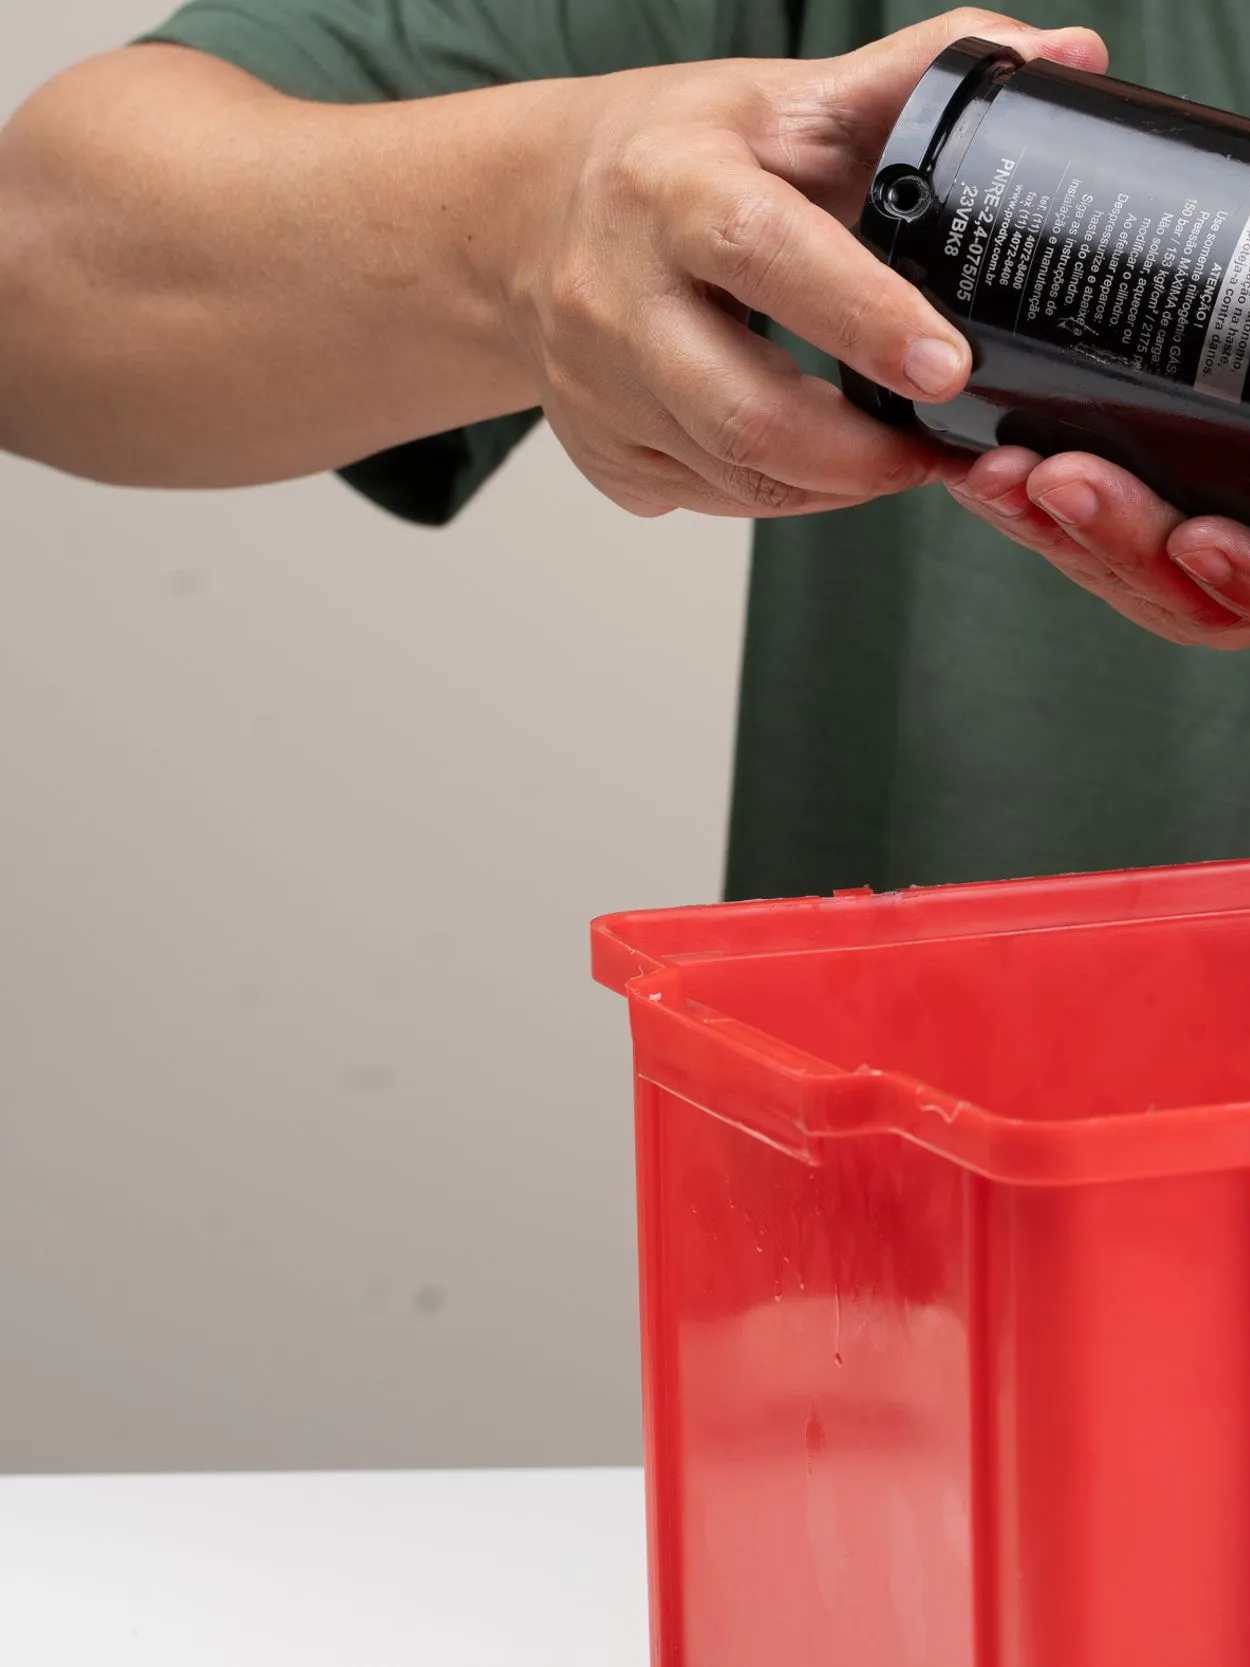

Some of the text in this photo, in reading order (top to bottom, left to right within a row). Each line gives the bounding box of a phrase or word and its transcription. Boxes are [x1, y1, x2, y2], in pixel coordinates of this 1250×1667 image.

[944, 185, 979, 257] 23VBK8
[956, 158, 1016, 302] PNRE-2,4-075/05
[1027, 213, 1044, 233] (11)
[1090, 192, 1129, 273] Despressurize
[1173, 217, 1190, 238] bar
[1181, 198, 1198, 218] 150
[1183, 210, 1211, 256] Pressão
[1210, 210, 1229, 232] Use
[984, 184, 1024, 287] www.prodty.com.br
[999, 191, 1037, 286] fax (11) 4072-8406
[1045, 193, 1094, 316] Siga as instruções de
[1048, 236, 1058, 245] e
[1063, 209, 1105, 306] haste do cilindro.
[1161, 247, 1178, 268] 153
[1191, 232, 1216, 282] somente
[1012, 234, 1036, 290] 4072-8400
[1026, 246, 1055, 321] manutenção.
[1087, 275, 1097, 284] e
[1093, 212, 1137, 324] Ao efetuar reparos:
[1108, 217, 1152, 327] modificar o cilindro.
[1121, 212, 1174, 345] Não soldar, aquecer ou
[1164, 257, 1192, 309] MÁXIMA
[1074, 285, 1094, 326] abaixe
[1172, 283, 1199, 343] nitrogênio
[1196, 262, 1223, 321] ATENÇÃO
[1214, 288, 1235, 331] contra
[1230, 307, 1243, 324] na
[1136, 322, 1154, 353] 2175
[1160, 310, 1173, 327] de
